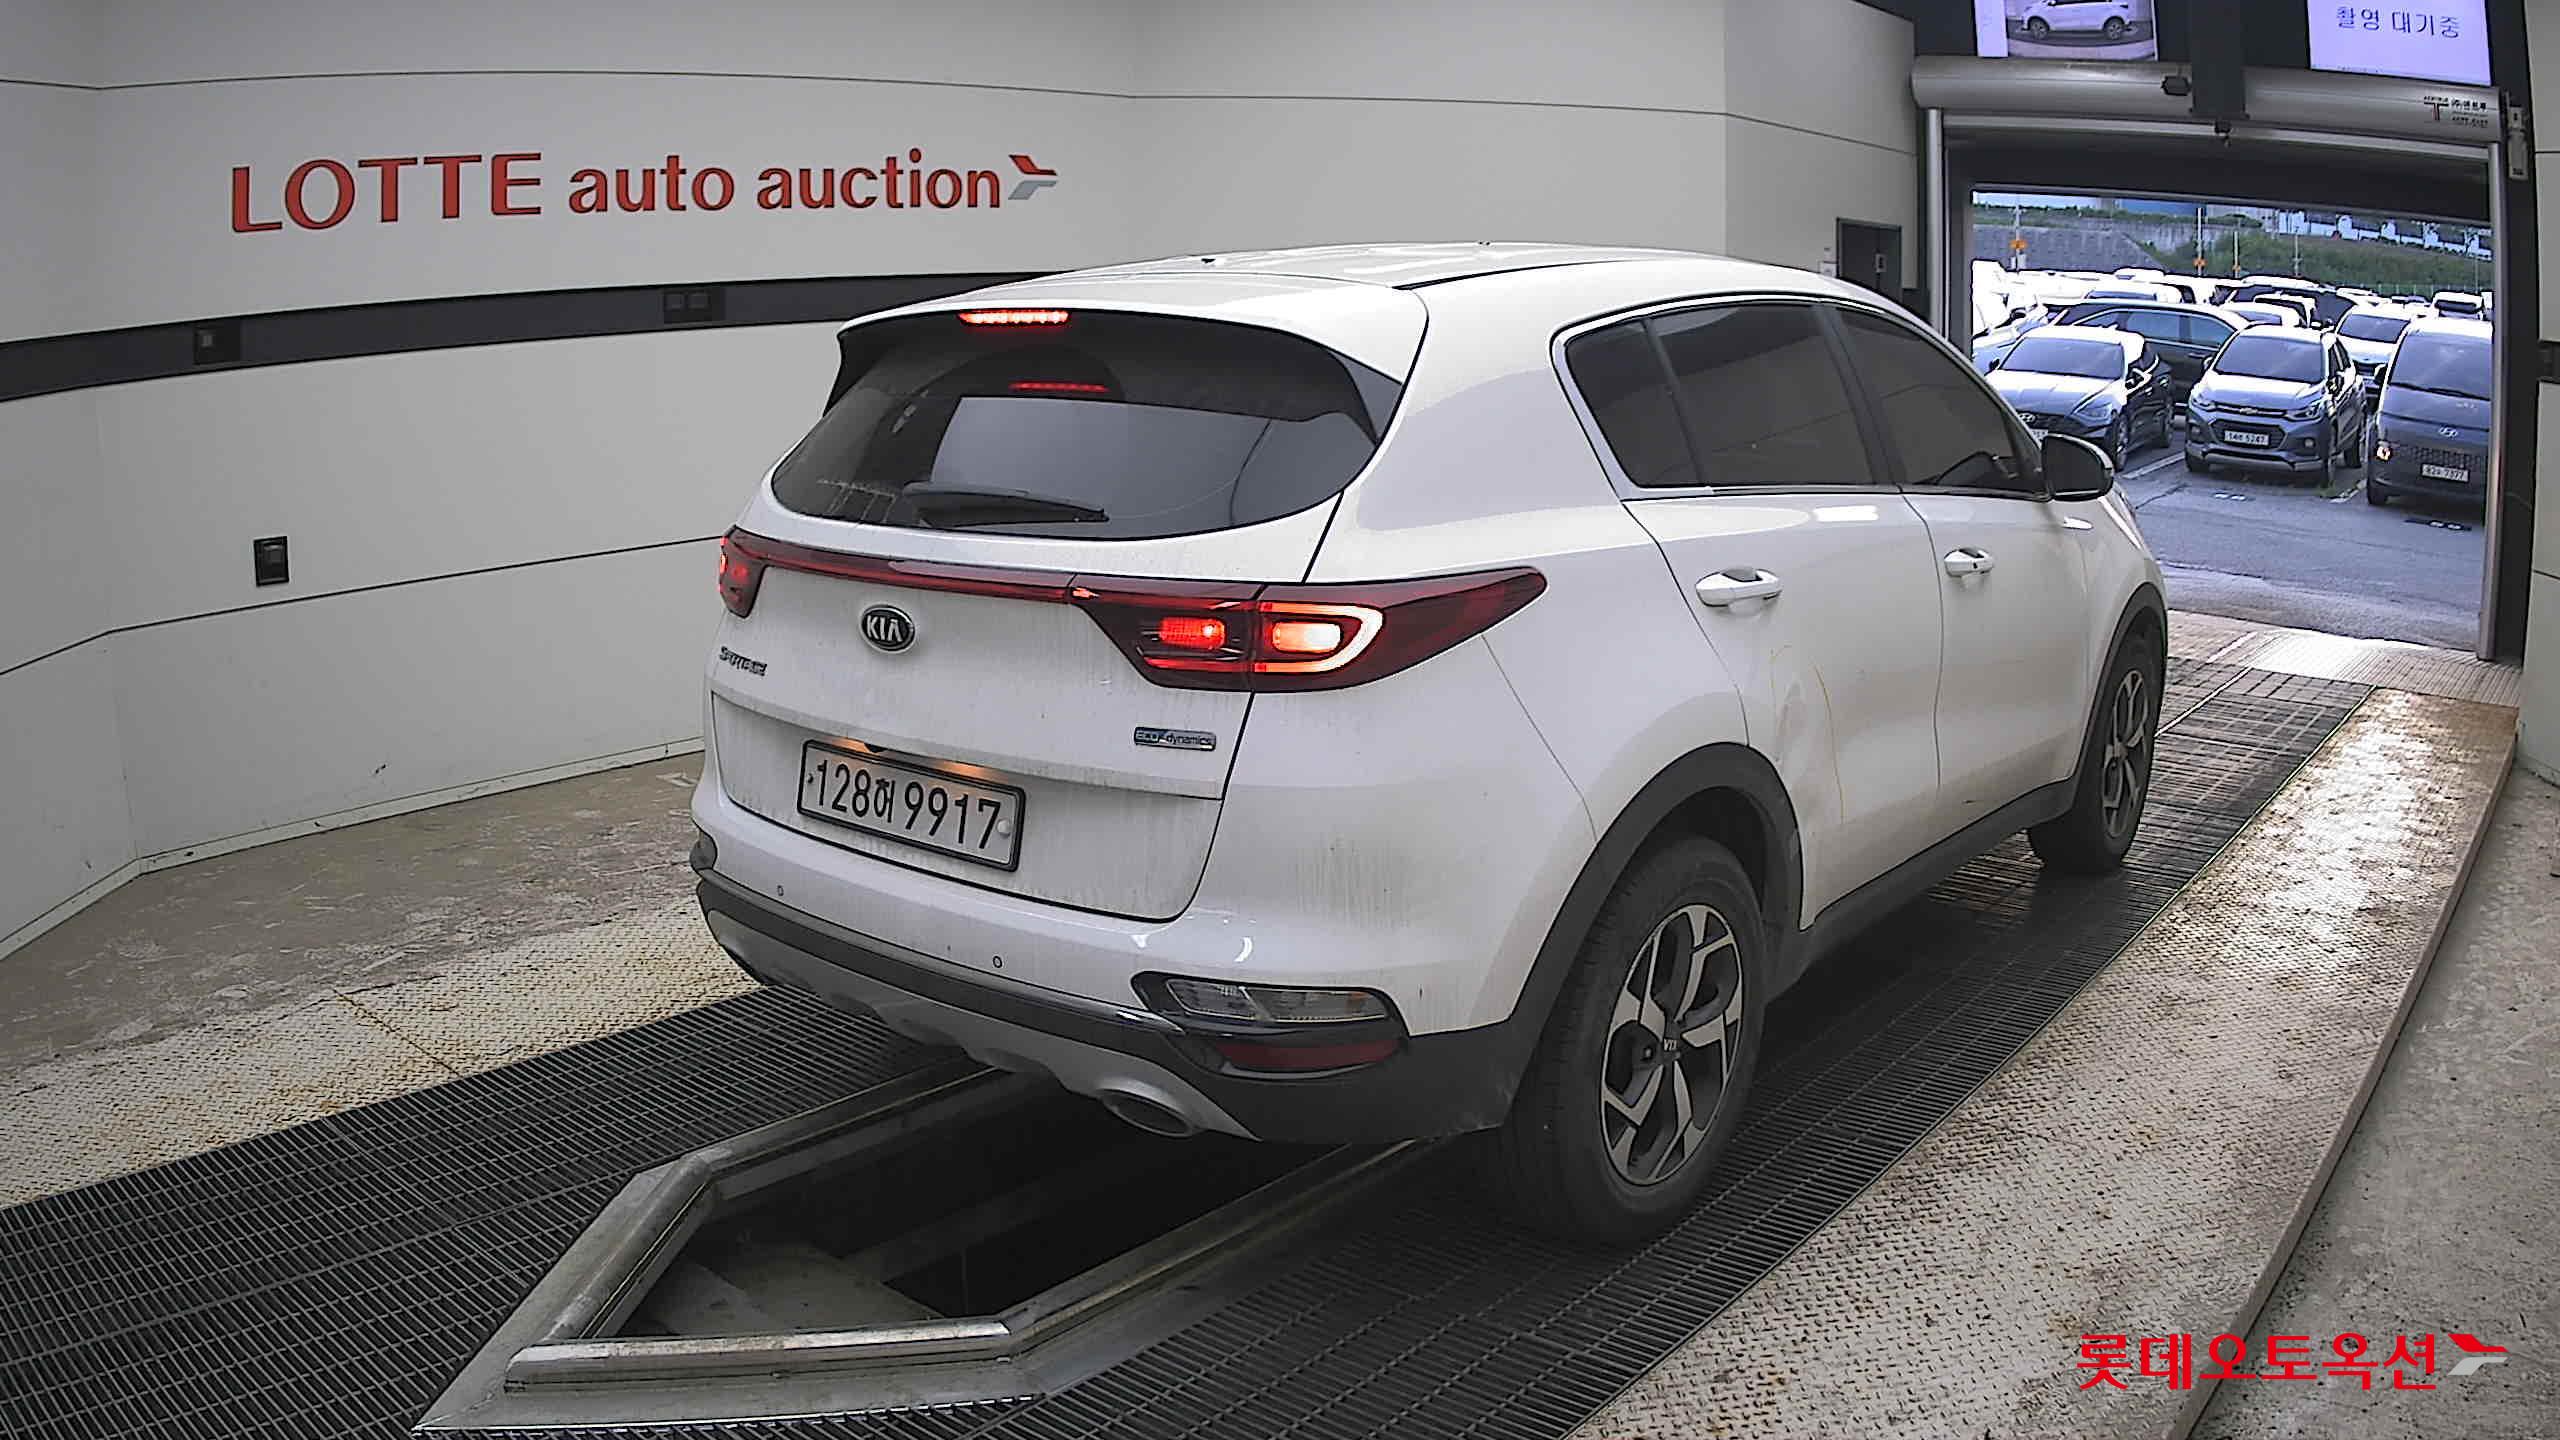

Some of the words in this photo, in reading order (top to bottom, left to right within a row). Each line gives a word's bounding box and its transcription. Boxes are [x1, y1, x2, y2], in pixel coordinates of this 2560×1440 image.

[2336, 6, 2380, 31] 촬영
[2391, 12, 2460, 39] 대기중
[231, 152, 542, 233] LOTTE
[568, 155, 735, 213] auto
[756, 148, 1001, 210] auction
[866, 614, 902, 642] KIA
[817, 759, 896, 823] 128허
[904, 781, 1001, 849] 9917
